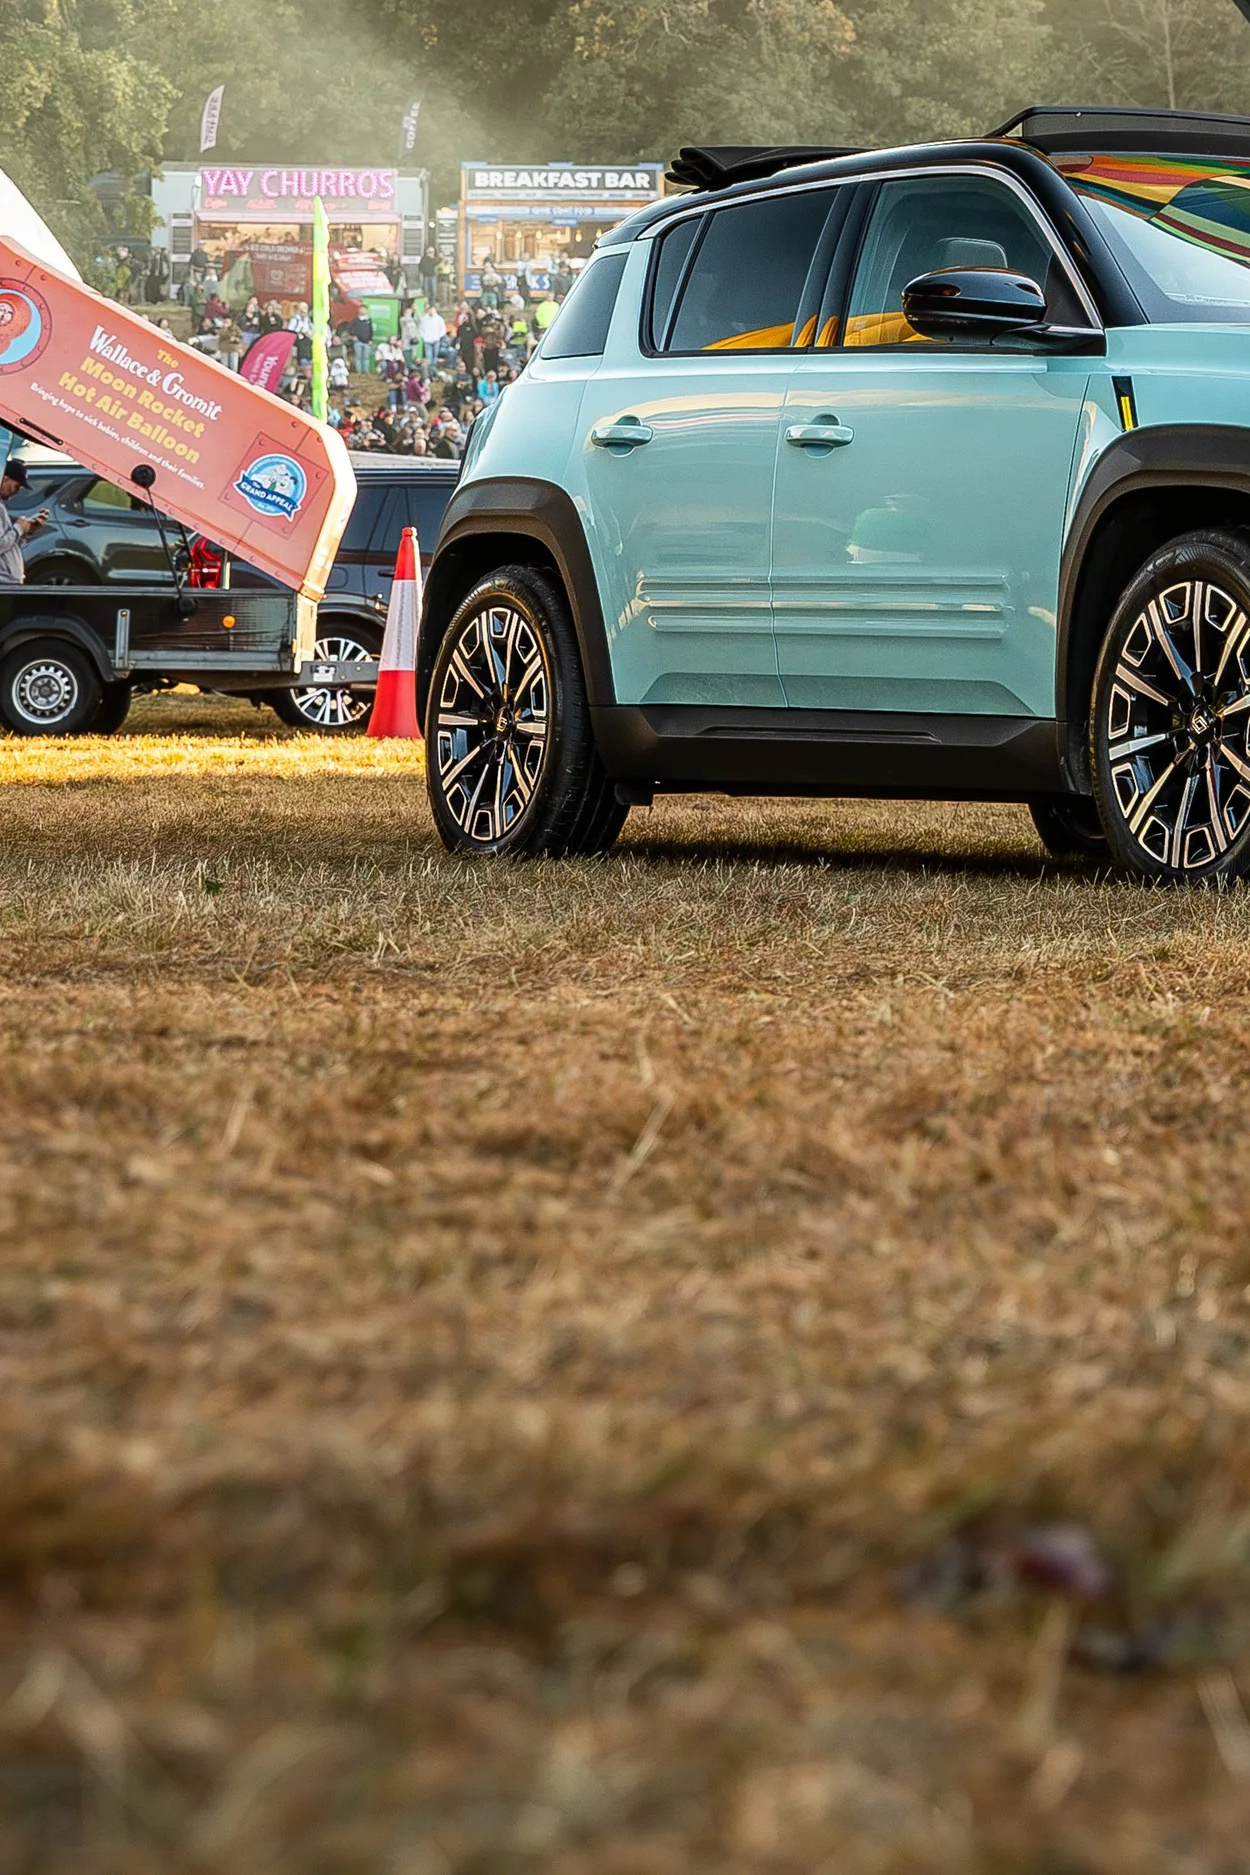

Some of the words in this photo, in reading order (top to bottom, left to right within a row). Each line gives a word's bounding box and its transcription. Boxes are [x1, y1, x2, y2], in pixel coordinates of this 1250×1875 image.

[203, 169, 254, 196] YAY
[260, 168, 395, 198] CHURROS
[474, 171, 602, 188] BREAKFAST
[604, 172, 651, 189] BAR
[89, 325, 148, 379] Wallace
[146, 369, 162, 386] &
[161, 372, 222, 420] Gromit
[156, 349, 179, 368] The
[57, 371, 97, 403] Hot
[95, 395, 128, 420] Air
[126, 412, 200, 464] Balloon
[79, 356, 138, 399] Moon
[137, 390, 206, 439] Rocket
[30, 382, 59, 406] Bringing
[59, 398, 76, 415] hope
[75, 409, 84, 419] to
[83, 413, 98, 427] sick
[120, 435, 148, 457] children
[148, 451, 163, 464] and
[161, 458, 179, 474] their
[240, 481, 267, 502] GRAND
[266, 493, 294, 512] APPEAL
